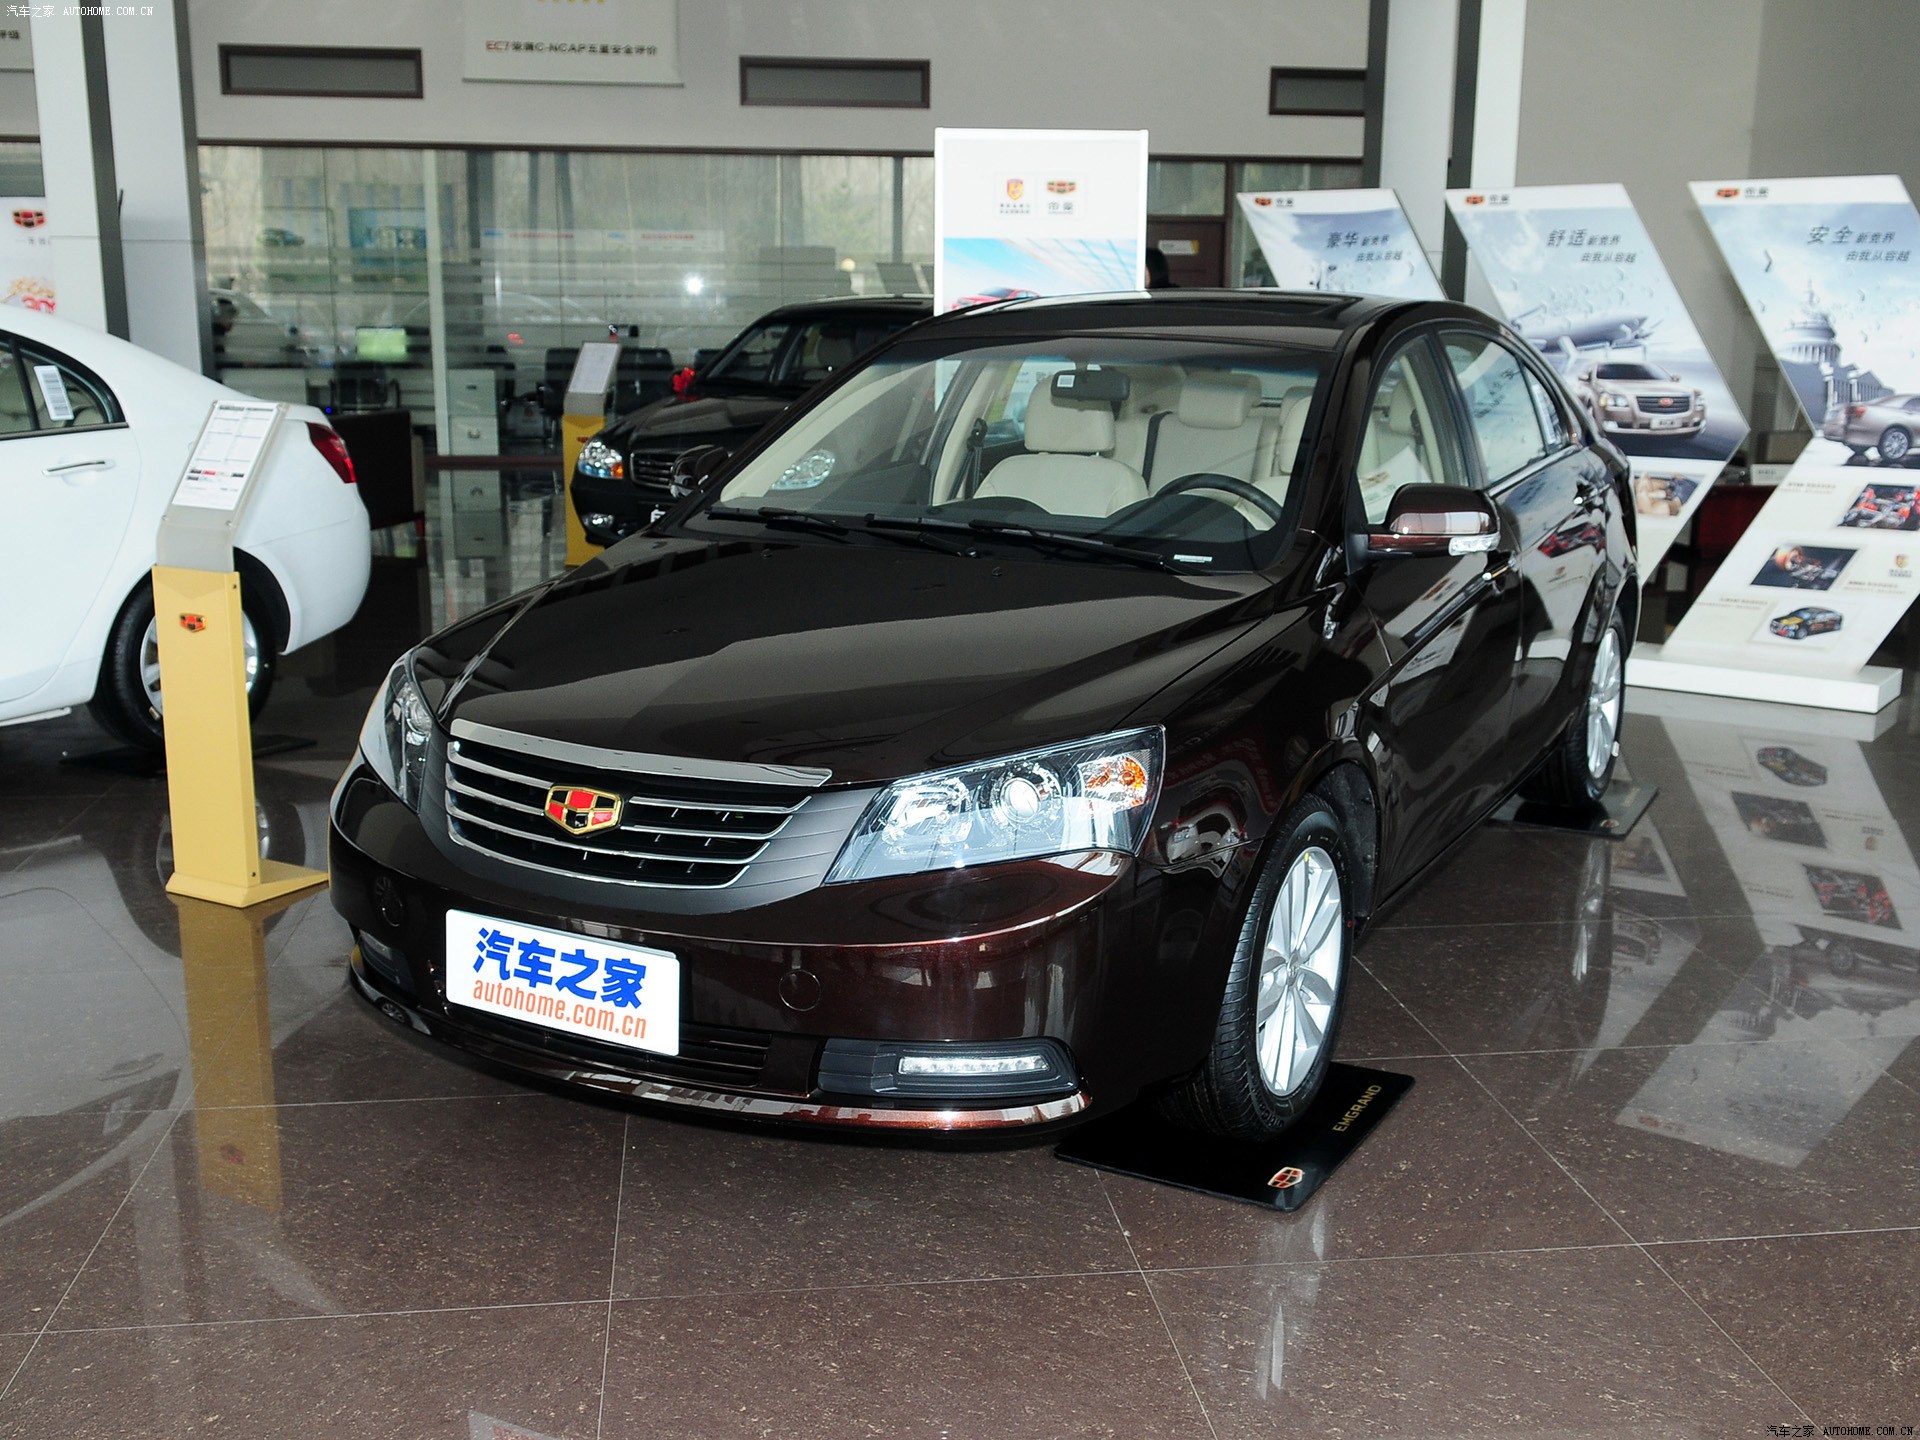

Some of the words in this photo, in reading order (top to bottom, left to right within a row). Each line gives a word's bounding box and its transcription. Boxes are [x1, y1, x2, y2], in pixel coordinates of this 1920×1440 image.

[472, 927, 647, 1009] 汽车之家
[473, 979, 647, 1039] autohome.com.cn
[1332, 1084, 1383, 1132] EMGRAND
